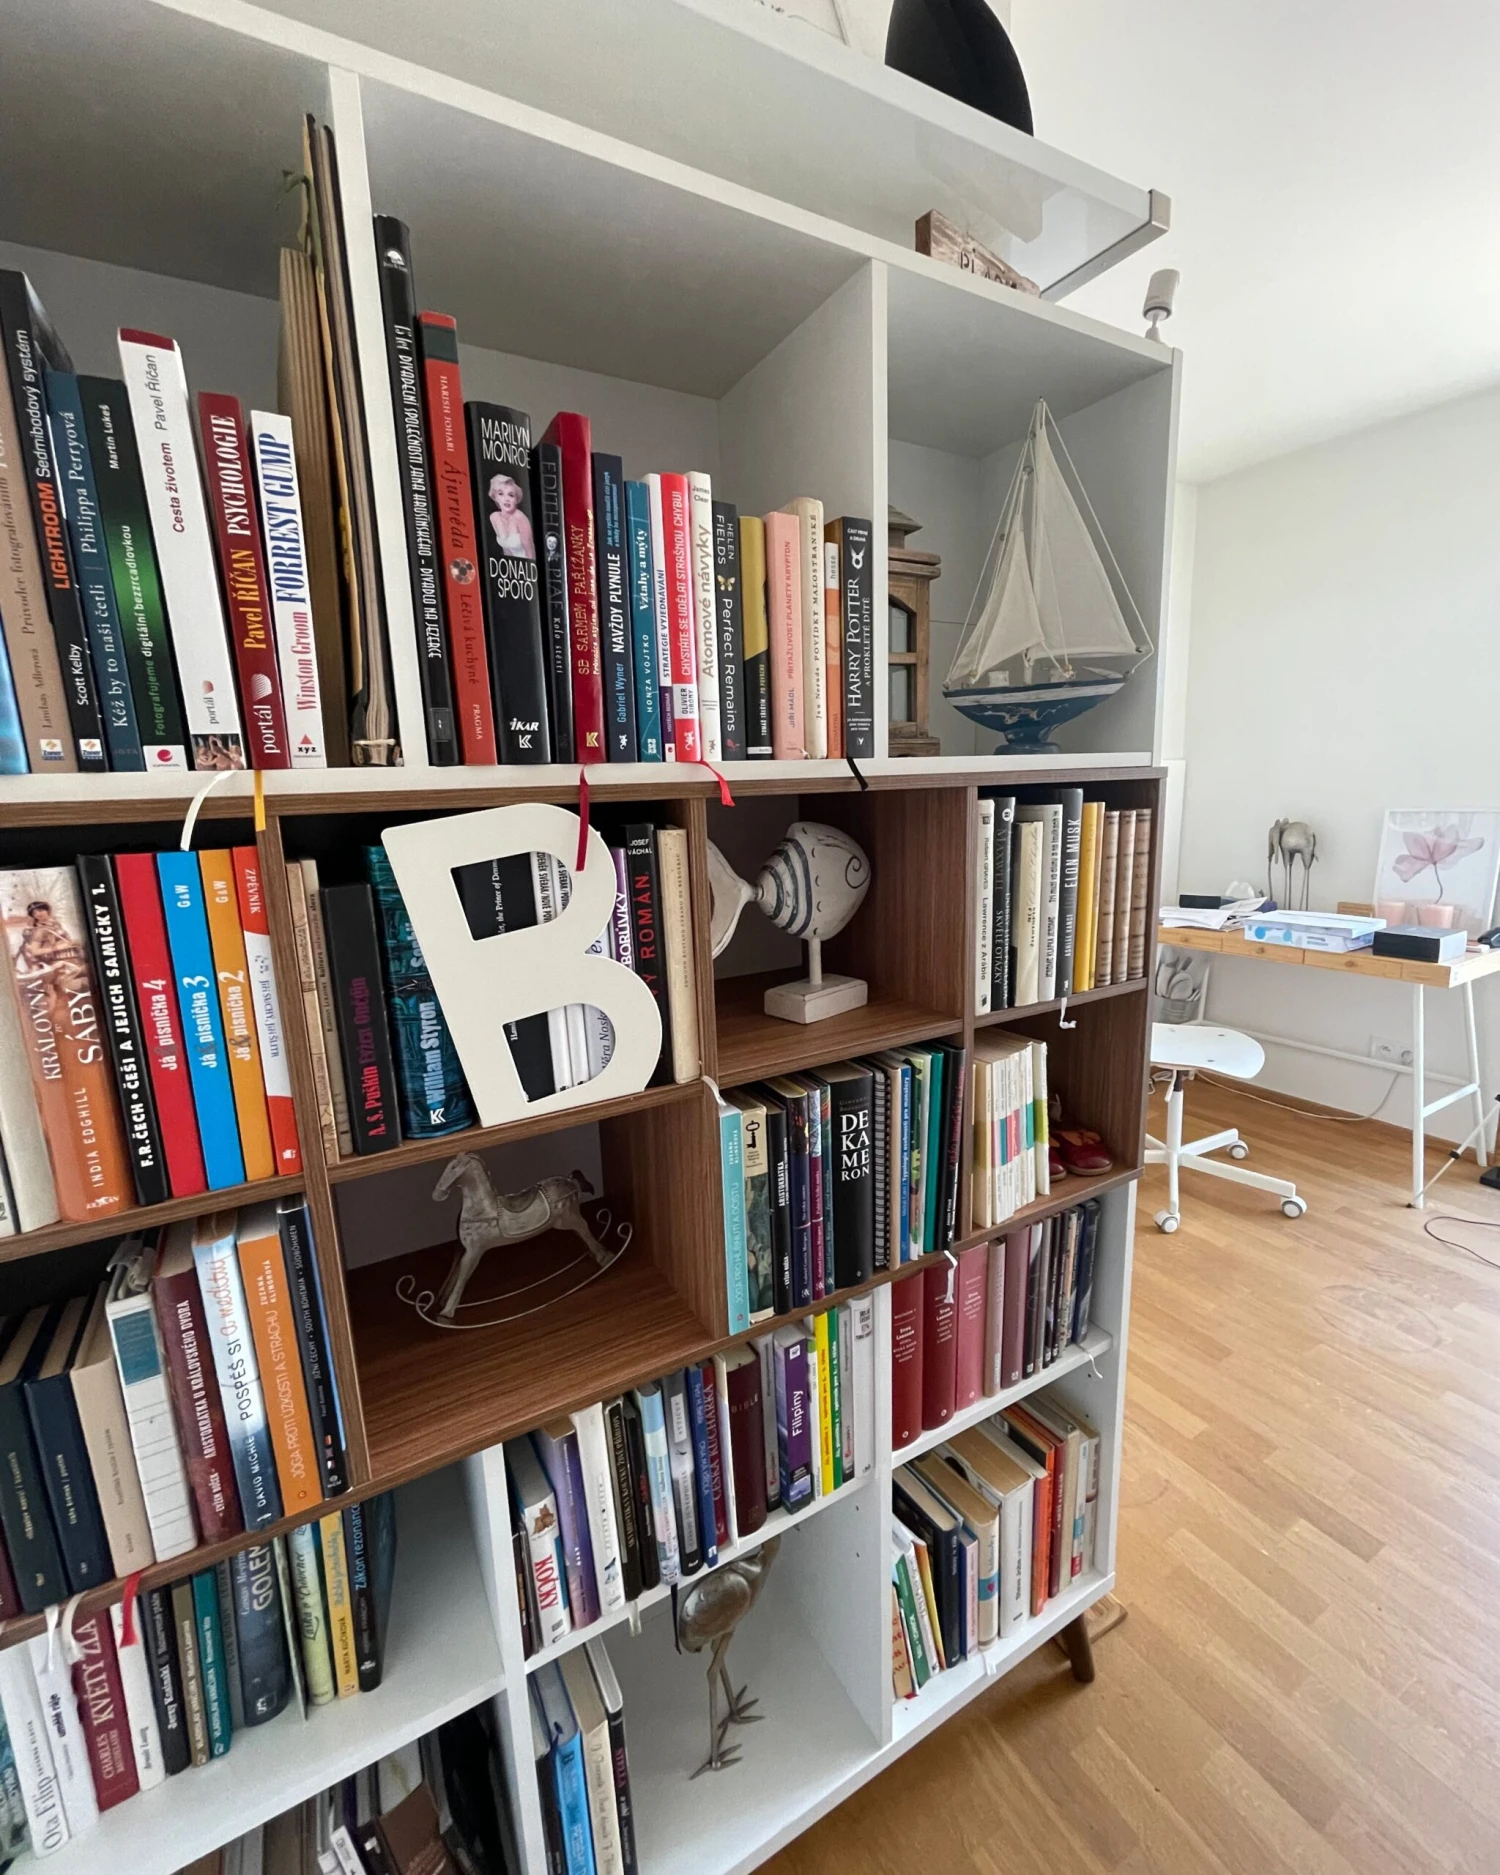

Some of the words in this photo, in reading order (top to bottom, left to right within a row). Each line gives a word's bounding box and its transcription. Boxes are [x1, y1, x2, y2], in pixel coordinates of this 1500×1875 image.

[16, 329, 38, 383] systém
[145, 354, 161, 393] Říčan
[399, 352, 418, 408] DIVADELNÍ
[440, 375, 454, 415] HARISH
[22, 384, 51, 479] Sedmibodový
[98, 403, 116, 435] Lukeš
[150, 393, 168, 432] Pavel
[481, 417, 530, 448] MARILYN
[58, 410, 85, 482] Perryová
[108, 435, 120, 470] Martin
[403, 408, 423, 465] SPOLEČNOSTI
[444, 414, 455, 453] JOHARI
[160, 442, 179, 494] životem
[258, 432, 297, 498] GUMP
[482, 438, 531, 470] MONROE
[210, 414, 252, 537] PSYCHOLOGIE
[541, 461, 559, 527] EDITH
[77, 488, 98, 554] Philippa
[168, 495, 186, 534] Cesta
[671, 490, 684, 527] CHYBU!
[36, 482, 70, 589] LIGHTROOM
[264, 501, 308, 605] FORREST
[638, 528, 648, 560] mýty
[716, 514, 726, 566] FIELDS
[726, 522, 735, 561] HELEN
[121, 525, 147, 610] bezzrcadlovkou
[230, 548, 260, 602] ŘÍČAN
[489, 557, 538, 583] DONALD
[570, 525, 588, 595] PAŘÍŽANKY
[673, 531, 686, 581] STRAŠNOU
[696, 524, 713, 595] návyky
[810, 513, 819, 607] MALOSTRANSKÉ
[418, 567, 437, 608] DIVADLO
[497, 579, 534, 602] SPOTO
[607, 552, 623, 603] PLYNULE
[637, 571, 652, 611] Vztahy
[89, 584, 108, 619] četli
[423, 608, 438, 621] NA
[675, 581, 689, 630] UDĚLAT
[785, 584, 793, 623] PLANETY
[846, 577, 863, 645] POTTER
[862, 597, 871, 624] DÍTĚ
[136, 609, 154, 658] digitální
[239, 606, 268, 650] Pavel
[290, 610, 309, 656] Groom
[424, 622, 442, 659] JEZERCE
[553, 616, 564, 640] Kolo
[608, 607, 625, 654] NAVŽDY
[700, 596, 714, 679] Atomové
[722, 598, 734, 659] Perfect
[69, 643, 83, 677] Kelby
[107, 657, 119, 673] to
[463, 636, 479, 685] kuchyně
[578, 659, 590, 676] SE
[642, 633, 652, 676] VOJTKO
[662, 632, 671, 678] STRATEGIE
[679, 640, 692, 677] CHYSTÁTE
[786, 624, 794, 680] PŘITAŽLIVOST
[863, 625, 871, 679] PROKLETÉ
[77, 677, 89, 706] Scott
[108, 677, 126, 697] by
[291, 657, 318, 712] Winston
[616, 662, 626, 691] Wyner
[645, 678, 655, 713] HONZA
[815, 666, 823, 701] Neruda
[847, 648, 863, 708] HARRY
[113, 699, 129, 728] Kéž
[148, 657, 166, 737] Fotografujeme
[204, 696, 220, 726] portál
[617, 691, 627, 723] Gabriel
[724, 663, 737, 732] Remains
[787, 687, 795, 711] MÁDL
[253, 703, 281, 755] portál
[472, 703, 484, 741] PRAGMA
[627, 847, 653, 856] VÁCHAL
[629, 838, 650, 847] JOSEF
[1066, 817, 1082, 858] MUSK
[91, 882, 106, 896] 1.
[244, 868, 262, 915] ZPĚVNÍK
[1064, 858, 1079, 890] ELON
[634, 874, 657, 960] ROMÁN
[94, 904, 121, 978] SAMIČKY
[142, 978, 168, 992] 4
[181, 974, 211, 989] 3
[217, 969, 246, 984] 2
[380, 803, 665, 1129] B
[980, 951, 988, 981] Arábie
[992, 949, 1004, 985] OTÁZKY
[64, 987, 105, 1065] SÁBY
[109, 984, 131, 1035] JEJICH
[150, 993, 176, 1047] písnička
[190, 990, 215, 1044] písnička
[226, 985, 250, 1037] písnička
[259, 980, 271, 993] Jiří
[268, 1034, 280, 1058] ŠLITR
[419, 1001, 442, 1051] Styron
[26, 979, 63, 1081] KRÁLOVNA
[119, 1039, 134, 1051] A
[119, 1057, 139, 1090] ČEŠI
[157, 1054, 179, 1071] Já
[198, 1052, 218, 1069] Já
[235, 1046, 252, 1061] Já
[361, 1065, 383, 1110] Puškin
[423, 1049, 447, 1106] William
[73, 1087, 96, 1145] EDGHILL
[130, 1102, 155, 1168] F.R.ČECH
[366, 1110, 384, 1124] S.
[368, 1123, 387, 1138] A.
[840, 1109, 870, 1134] DE
[840, 1130, 871, 1152] KA
[841, 1148, 871, 1170] ME
[87, 1150, 105, 1189] INDIA
[841, 1164, 870, 1182] RON
[256, 1275, 268, 1306] ZUZANA
[261, 1258, 278, 1304] KLINGROVÁ
[177, 1299, 191, 1329] DVORA
[227, 1337, 242, 1355] SI
[266, 1309, 286, 1362] STRACHU
[182, 1329, 203, 1389] KRÁLOVSKÉHO
[190, 1388, 204, 1400] U
[229, 1358, 253, 1422] POSPĚŠ
[730, 1392, 760, 1414] BIBLE
[191, 1399, 216, 1459] ARISTOKRATKA
[284, 1417, 302, 1449] PROTI
[792, 1389, 804, 1437] Filipíny
[249, 1436, 263, 1473] MICHIE
[253, 1472, 267, 1507] DAVID
[350, 1502, 366, 1560] rezonance
[354, 1561, 367, 1592] Zákon
[533, 1553, 560, 1612] KOČKY
[75, 1617, 102, 1655] ZLA
[48, 1693, 61, 1711] ráje
[81, 1660, 115, 1727] KVĚTY
[159, 1663, 175, 1705] Kosinski
[52, 1711, 67, 1739] umělé
[166, 1701, 179, 1730] Jerzy
[95, 1732, 115, 1780] CHARLES
[43, 1814, 62, 1850] Ota
